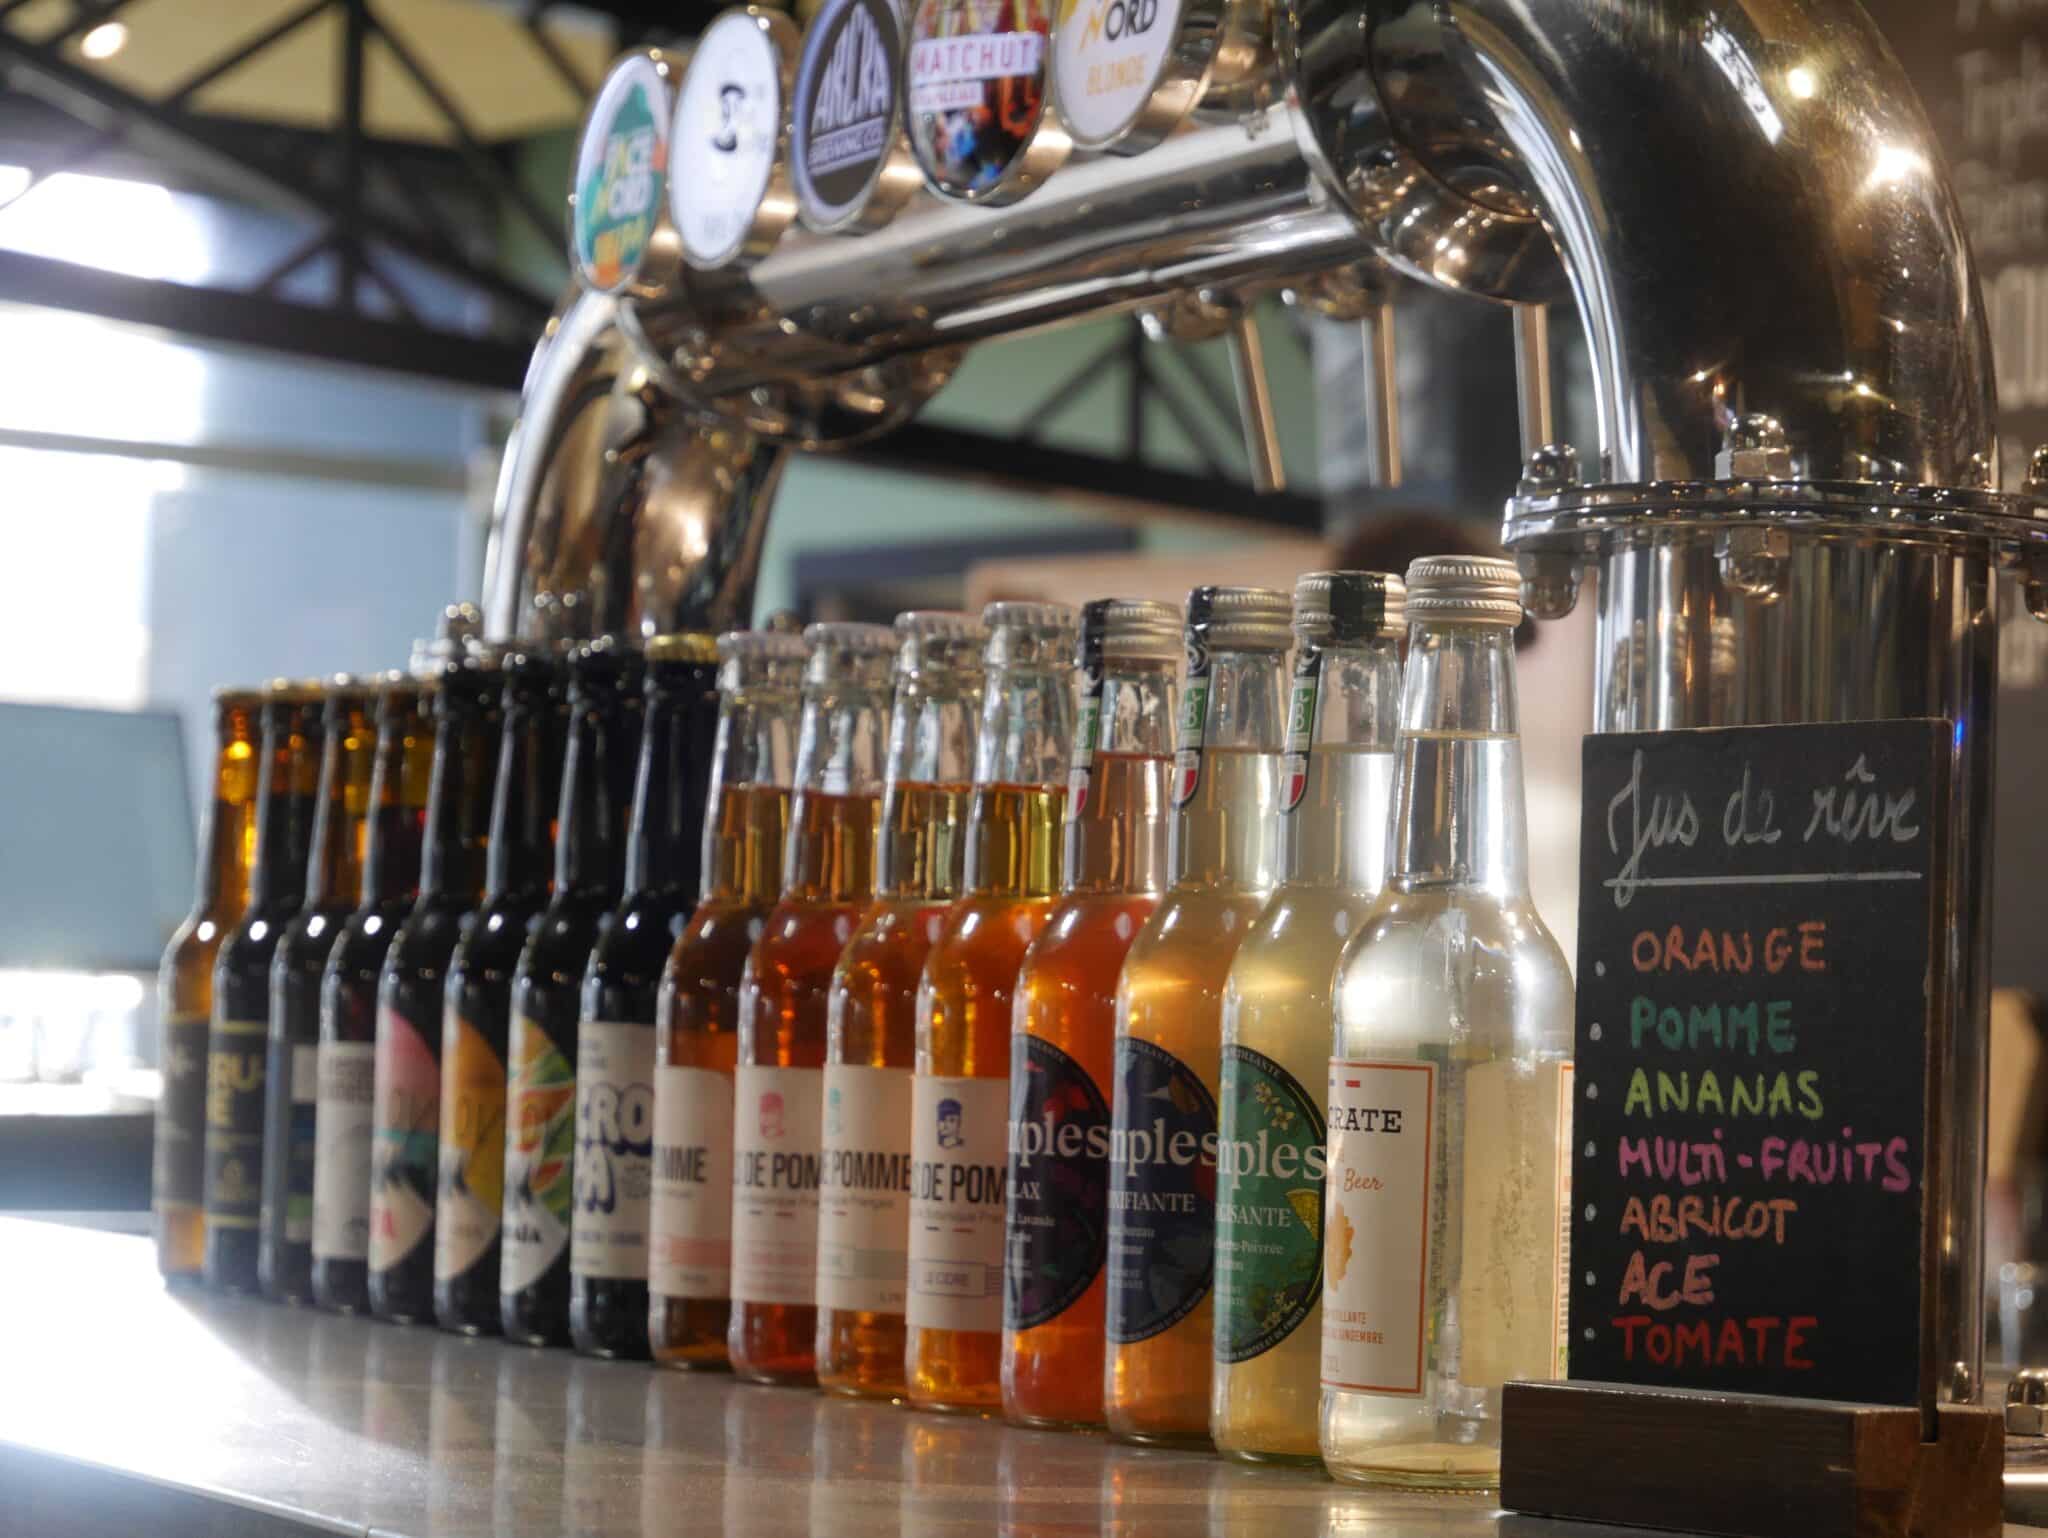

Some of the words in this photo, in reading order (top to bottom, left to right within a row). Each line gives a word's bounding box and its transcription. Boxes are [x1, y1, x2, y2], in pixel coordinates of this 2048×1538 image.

[1607, 749, 1699, 907] Jus
[1722, 760, 1783, 846] de
[1803, 752, 1921, 843] rêve
[1631, 921, 1827, 974] ORANGE
[1630, 996, 1797, 1056] POMME
[1624, 1067, 1825, 1120] ANANAS
[833, 1150, 912, 1192] POMME
[1343, 1167, 1384, 1192] Beer
[1618, 1249, 1721, 1311] ACE
[1611, 1315, 1819, 1369] TOMATE
